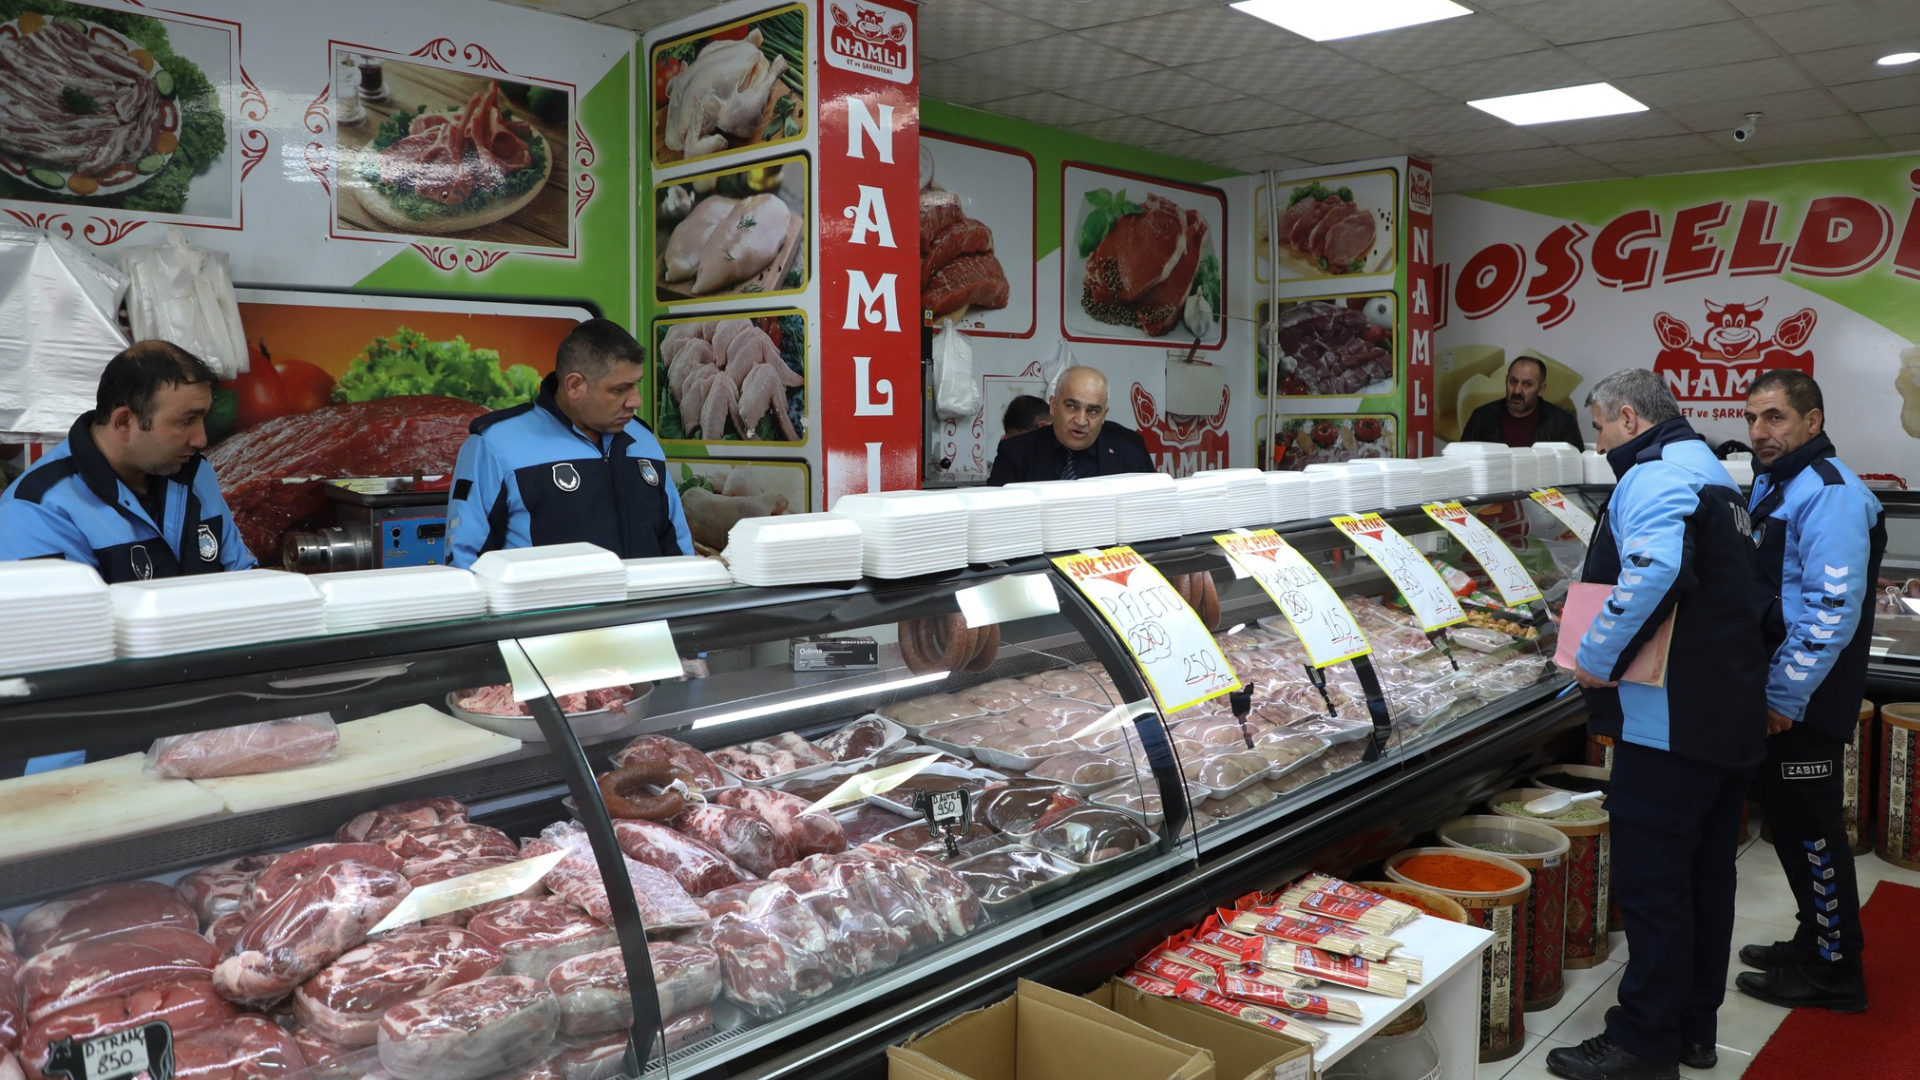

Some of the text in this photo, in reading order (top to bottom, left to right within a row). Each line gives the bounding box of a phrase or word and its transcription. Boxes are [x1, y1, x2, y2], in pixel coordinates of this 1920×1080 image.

[836, 36, 902, 67] NAMLI
[862, 62, 893, 75] ŞARKÜTERİ
[842, 97, 902, 492] NAMLI
[1411, 226, 1430, 458] NAMLI
[1662, 368, 1792, 398] NAM
[1681, 407, 1746, 421] ET ve ŞARK
[1149, 450, 1223, 479] AMLI
[1250, 533, 1284, 550] FİYAT
[1068, 551, 1142, 581] ŞOK FİYAT
[1503, 565, 1529, 589] 250
[1428, 586, 1452, 612] 145
[1320, 607, 1352, 642] 165
[1183, 649, 1217, 683] 250
[1217, 674, 1234, 683] TL
[1788, 764, 1828, 775] ZABITA
[938, 801, 956, 815] 950
[97, 1048, 134, 1075] 850
